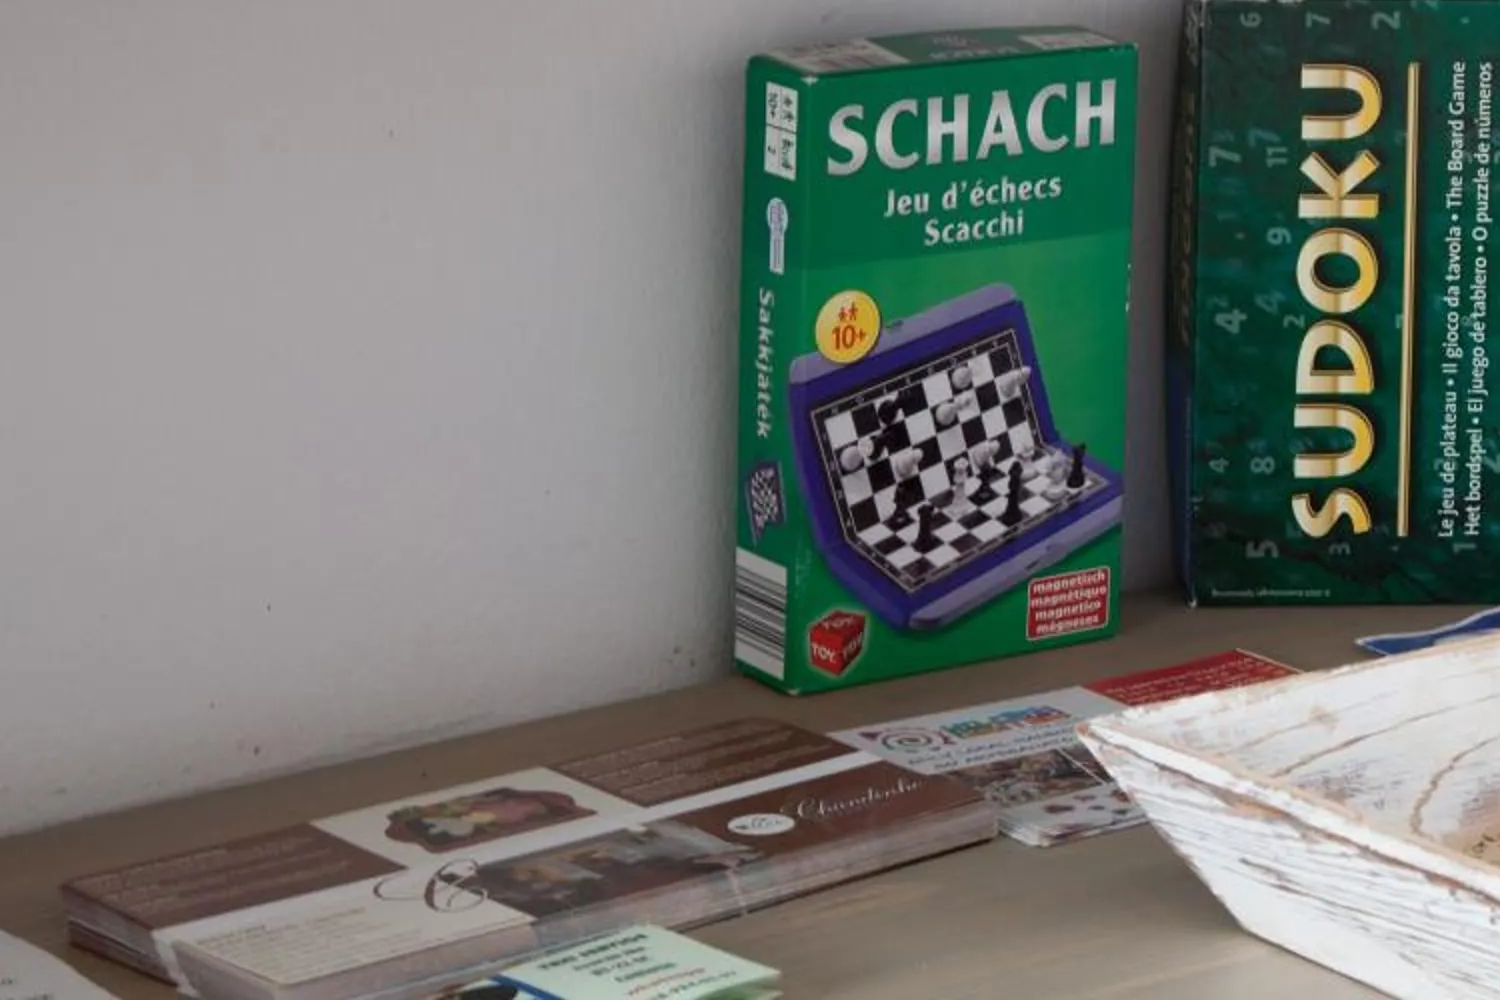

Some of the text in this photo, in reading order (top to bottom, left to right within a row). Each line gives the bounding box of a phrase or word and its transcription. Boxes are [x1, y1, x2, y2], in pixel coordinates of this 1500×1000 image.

[826, 78, 1117, 176] SCHACH
[883, 175, 1062, 217] Jeu d'échecs
[923, 209, 1024, 247] Scacchi
[1292, 63, 1382, 538] SUDOKU
[1437, 61, 1465, 537] Le jeu de plateau Il gioco da tavola The Board Game
[1464, 61, 1493, 535] Het bordspel El juego de tablero O puzzle de números
[831, 322, 867, 350] 10+
[1031, 571, 1106, 594] magnetisch
[1033, 599, 1101, 621] magnetico
[811, 641, 837, 665] TOY
